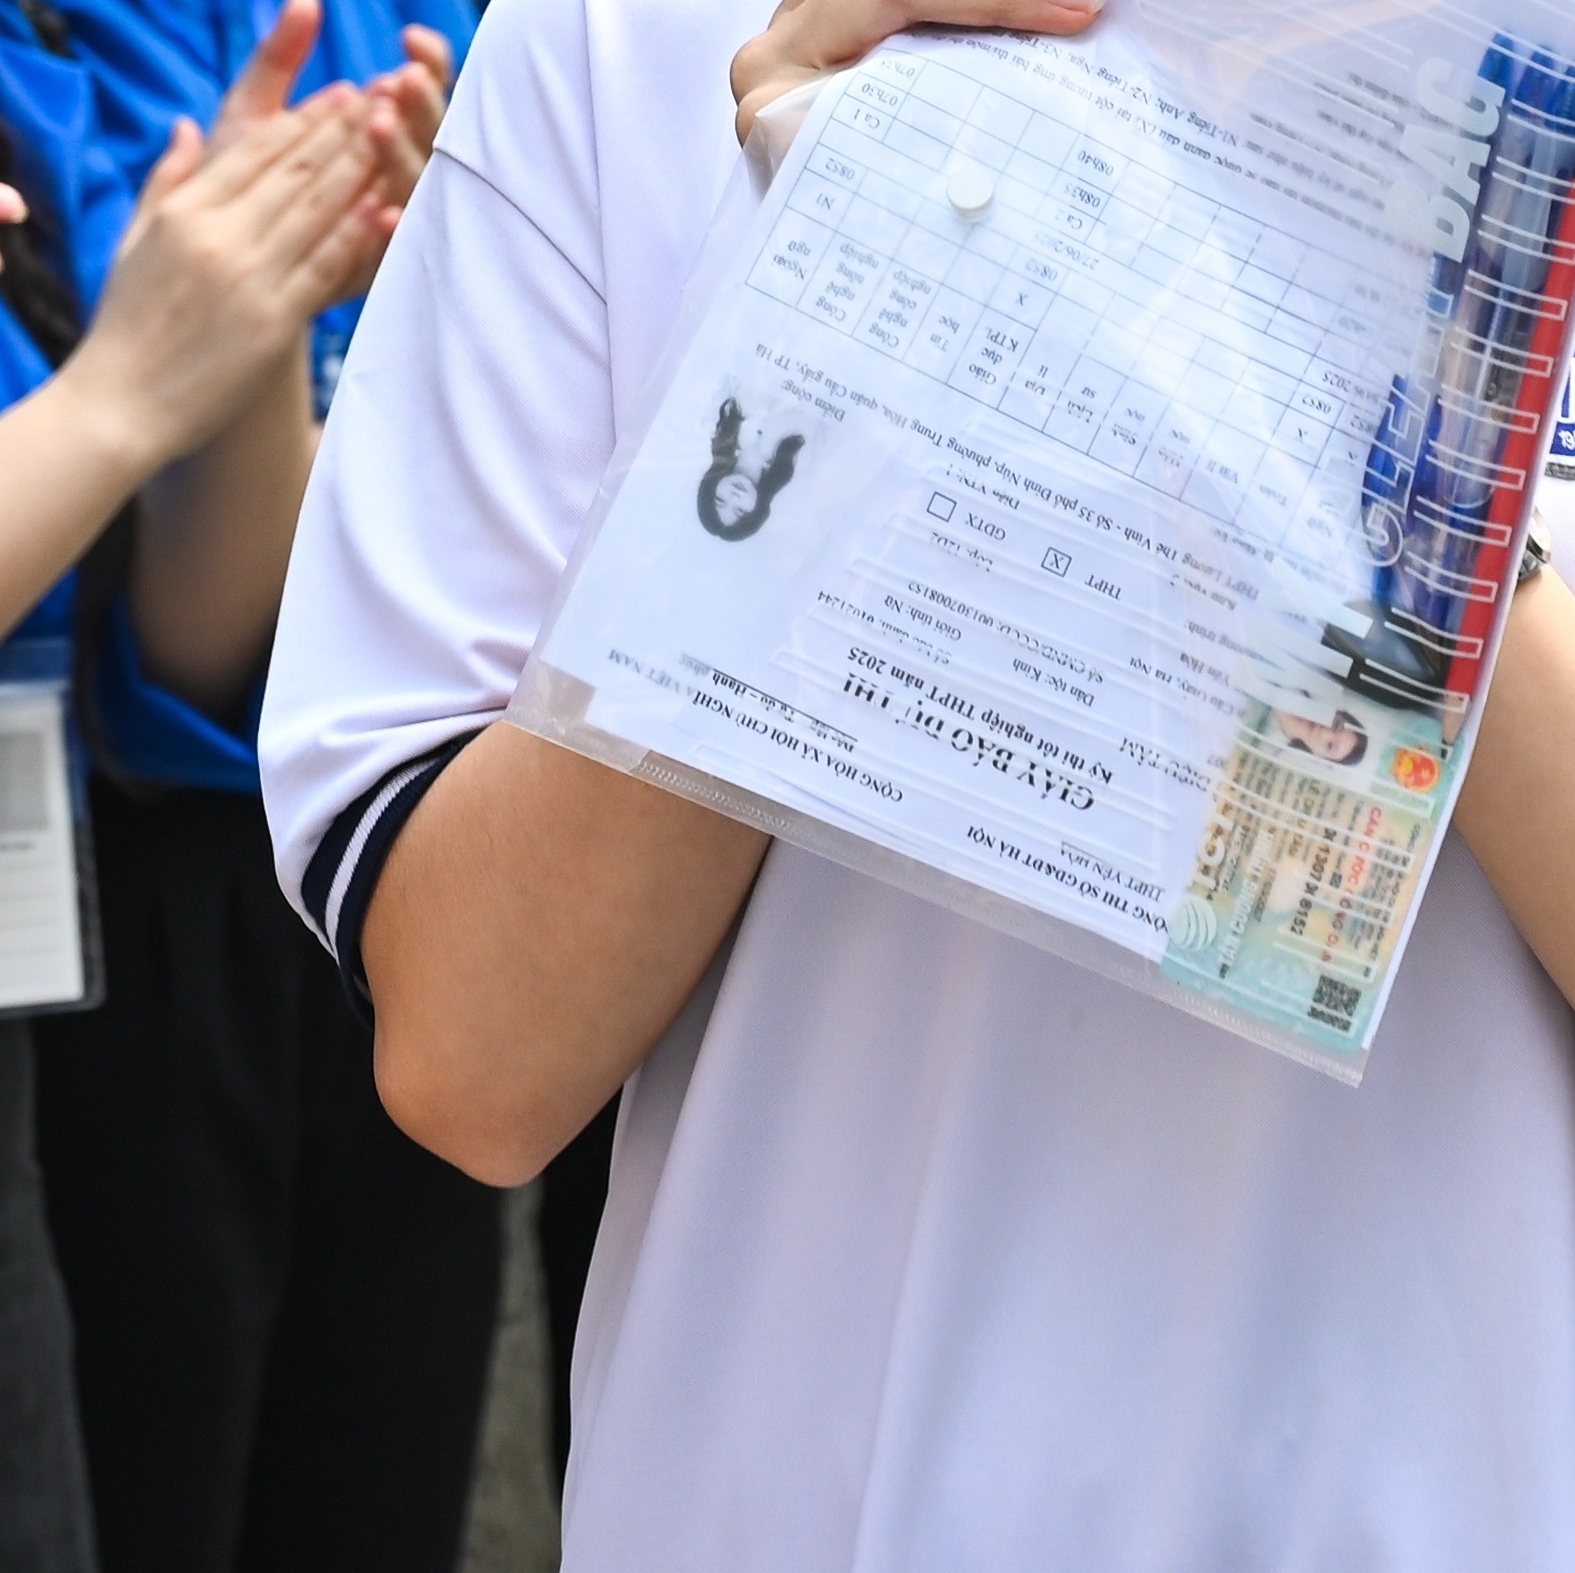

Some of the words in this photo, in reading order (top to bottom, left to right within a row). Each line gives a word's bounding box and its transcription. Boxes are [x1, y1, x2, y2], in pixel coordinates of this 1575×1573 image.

[1009, 53, 1030, 71] bài
[1063, 50, 1095, 75] Nga;
[859, 80, 898, 107] 07h30
[1092, 65, 1154, 107] N2-Tiếng
[851, 107, 862, 120] 1
[861, 112, 881, 130] Ca
[1152, 96, 1185, 120] Anh;
[1183, 109, 1241, 150] N1-Tiếng
[823, 156, 856, 180] 0852
[1075, 148, 1115, 176] 08h40
[1381, 53, 1509, 261] BAG
[814, 191, 835, 210] N1
[1062, 181, 1102, 208] 08h35
[1064, 213, 1084, 231] Ca
[784, 236, 812, 259] ngữ
[837, 240, 881, 272] nghiệp
[1031, 229, 1099, 271] 27/06/2025
[770, 251, 809, 280] Ngoại
[833, 261, 866, 287] nông
[1024, 256, 1059, 282] 0852
[823, 279, 857, 305] nghệ
[890, 267, 933, 298] nghiệp
[812, 294, 849, 323] Công
[887, 287, 918, 313] công
[1013, 290, 1028, 307] X
[876, 305, 909, 331] nghệ
[936, 312, 961, 335] học
[866, 321, 902, 349] Công
[927, 331, 951, 352] Tin
[981, 325, 1019, 351] KTPL
[772, 352, 791, 369] TP
[978, 345, 1004, 367] dục
[965, 361, 998, 387] Giáo
[779, 377, 814, 404] cộng:
[820, 376, 848, 401] Cầu
[847, 388, 879, 413] quận
[810, 395, 846, 423] Điểm
[907, 417, 946, 447] Trung
[943, 435, 992, 470] phường
[989, 458, 1023, 486] Núp,
[1050, 490, 1078, 516] phố
[1077, 504, 1095, 521] 35
[963, 511, 1008, 542] GDTX
[1092, 513, 1113, 533] Số
[1121, 526, 1154, 549] Vinh
[1048, 552, 1064, 569] X
[1084, 572, 1123, 599] THPT
[903, 604, 933, 627] tính:
[932, 618, 963, 642] Giới
[607, 648, 645, 674] NAM
[846, 644, 887, 674] 2025
[1010, 657, 1042, 681] Kinh
[886, 664, 925, 693] năm
[1042, 671, 1068, 693] tộc:
[681, 685, 734, 720] NGHĨA
[925, 683, 979, 719] THPT
[1067, 684, 1095, 706] Dân
[767, 725, 800, 752] HỘI
[977, 706, 1036, 747] nghiệp
[797, 742, 823, 764] XÃ
[943, 725, 1015, 780] BÁO
[1060, 749, 1086, 772] thi
[820, 753, 859, 783] HÒA
[858, 769, 906, 803] CỘNG
[1012, 758, 1098, 819] GIẤY
[964, 823, 997, 849] NỘI
[994, 840, 1021, 862] HÀ
[1020, 851, 1079, 888] GD&ĐT
[1090, 860, 1124, 886] YÊN
[1100, 890, 1131, 913] THI
[1124, 875, 1163, 902] THPT
